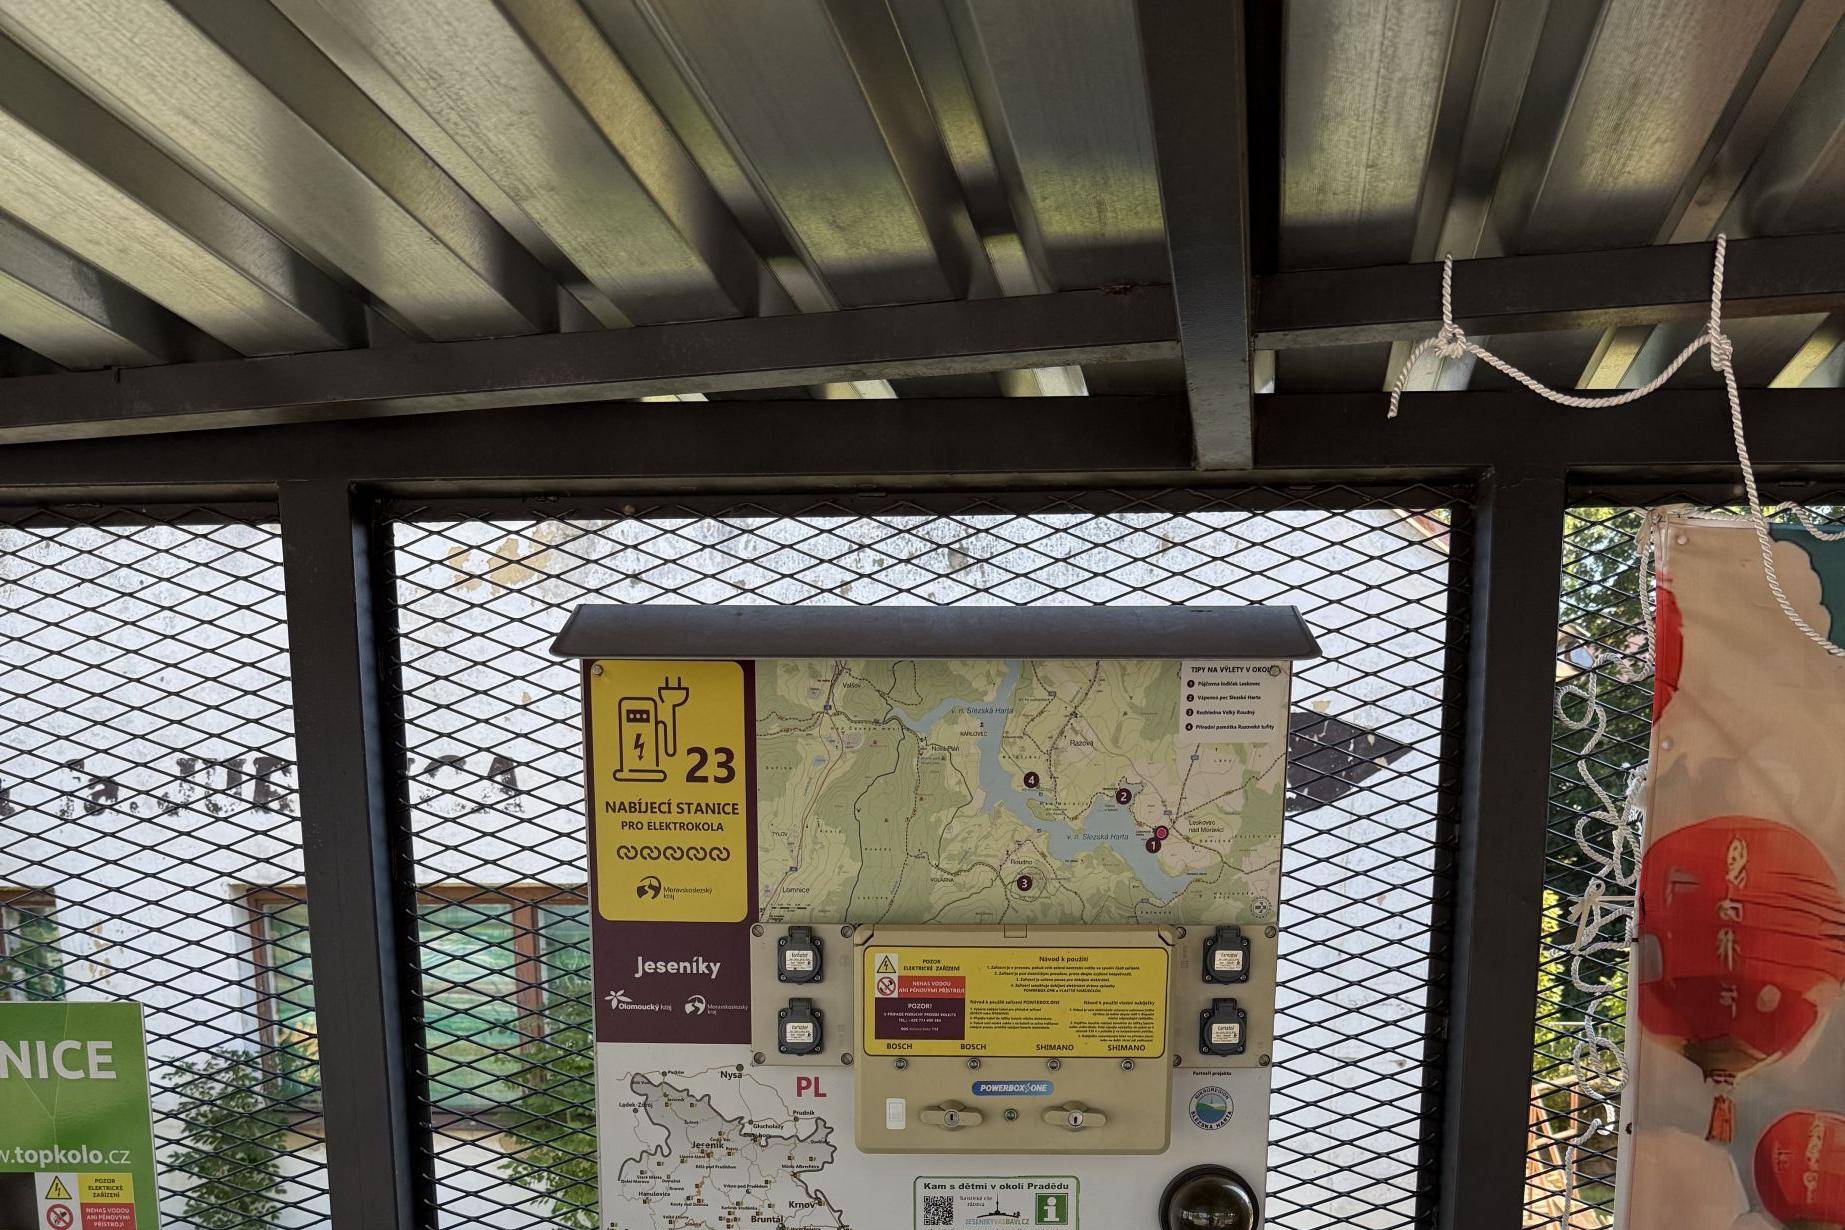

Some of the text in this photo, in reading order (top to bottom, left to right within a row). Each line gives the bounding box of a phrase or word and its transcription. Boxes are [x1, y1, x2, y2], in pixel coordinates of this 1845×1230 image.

[1220, 665, 1244, 673] VÝLETY
[686, 746, 736, 784] 23
[605, 798, 740, 816] NABÍJECÍ STANICE
[621, 821, 724, 832] PRO ELEKTROKOLA
[634, 956, 721, 979] Jeseníky
[618, 1003, 660, 1012] Olomoucký
[886, 1042, 912, 1050] BOSCH
[720, 1070, 742, 1080] Nysa
[796, 1076, 827, 1098] PL
[959, 1182, 987, 1190] dětmi
[1027, 1182, 1068, 1190] Pradědu
[789, 1200, 815, 1208] Krnov
